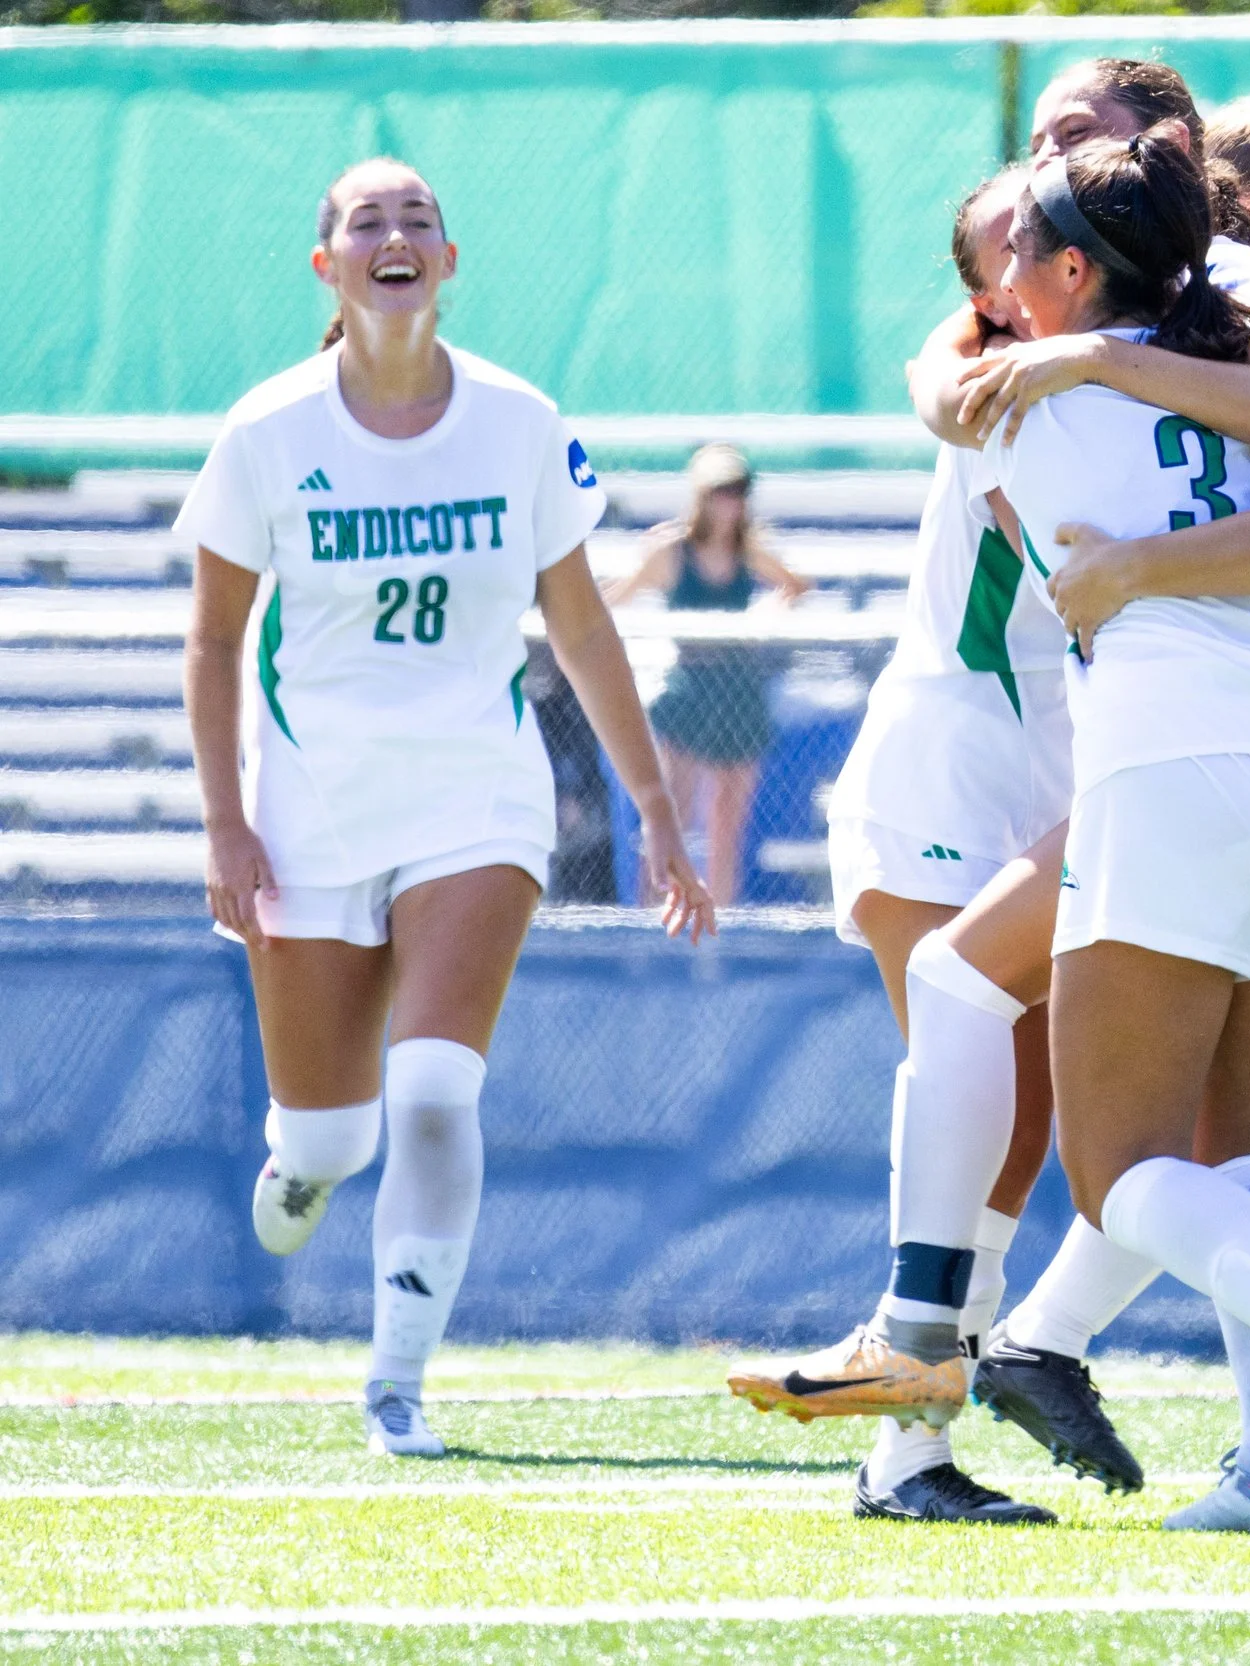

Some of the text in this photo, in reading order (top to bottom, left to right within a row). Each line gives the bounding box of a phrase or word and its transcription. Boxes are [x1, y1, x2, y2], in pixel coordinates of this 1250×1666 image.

[1154, 413, 1238, 533] 3
[307, 496, 508, 562] ENDICOTT
[373, 575, 449, 644] 28
